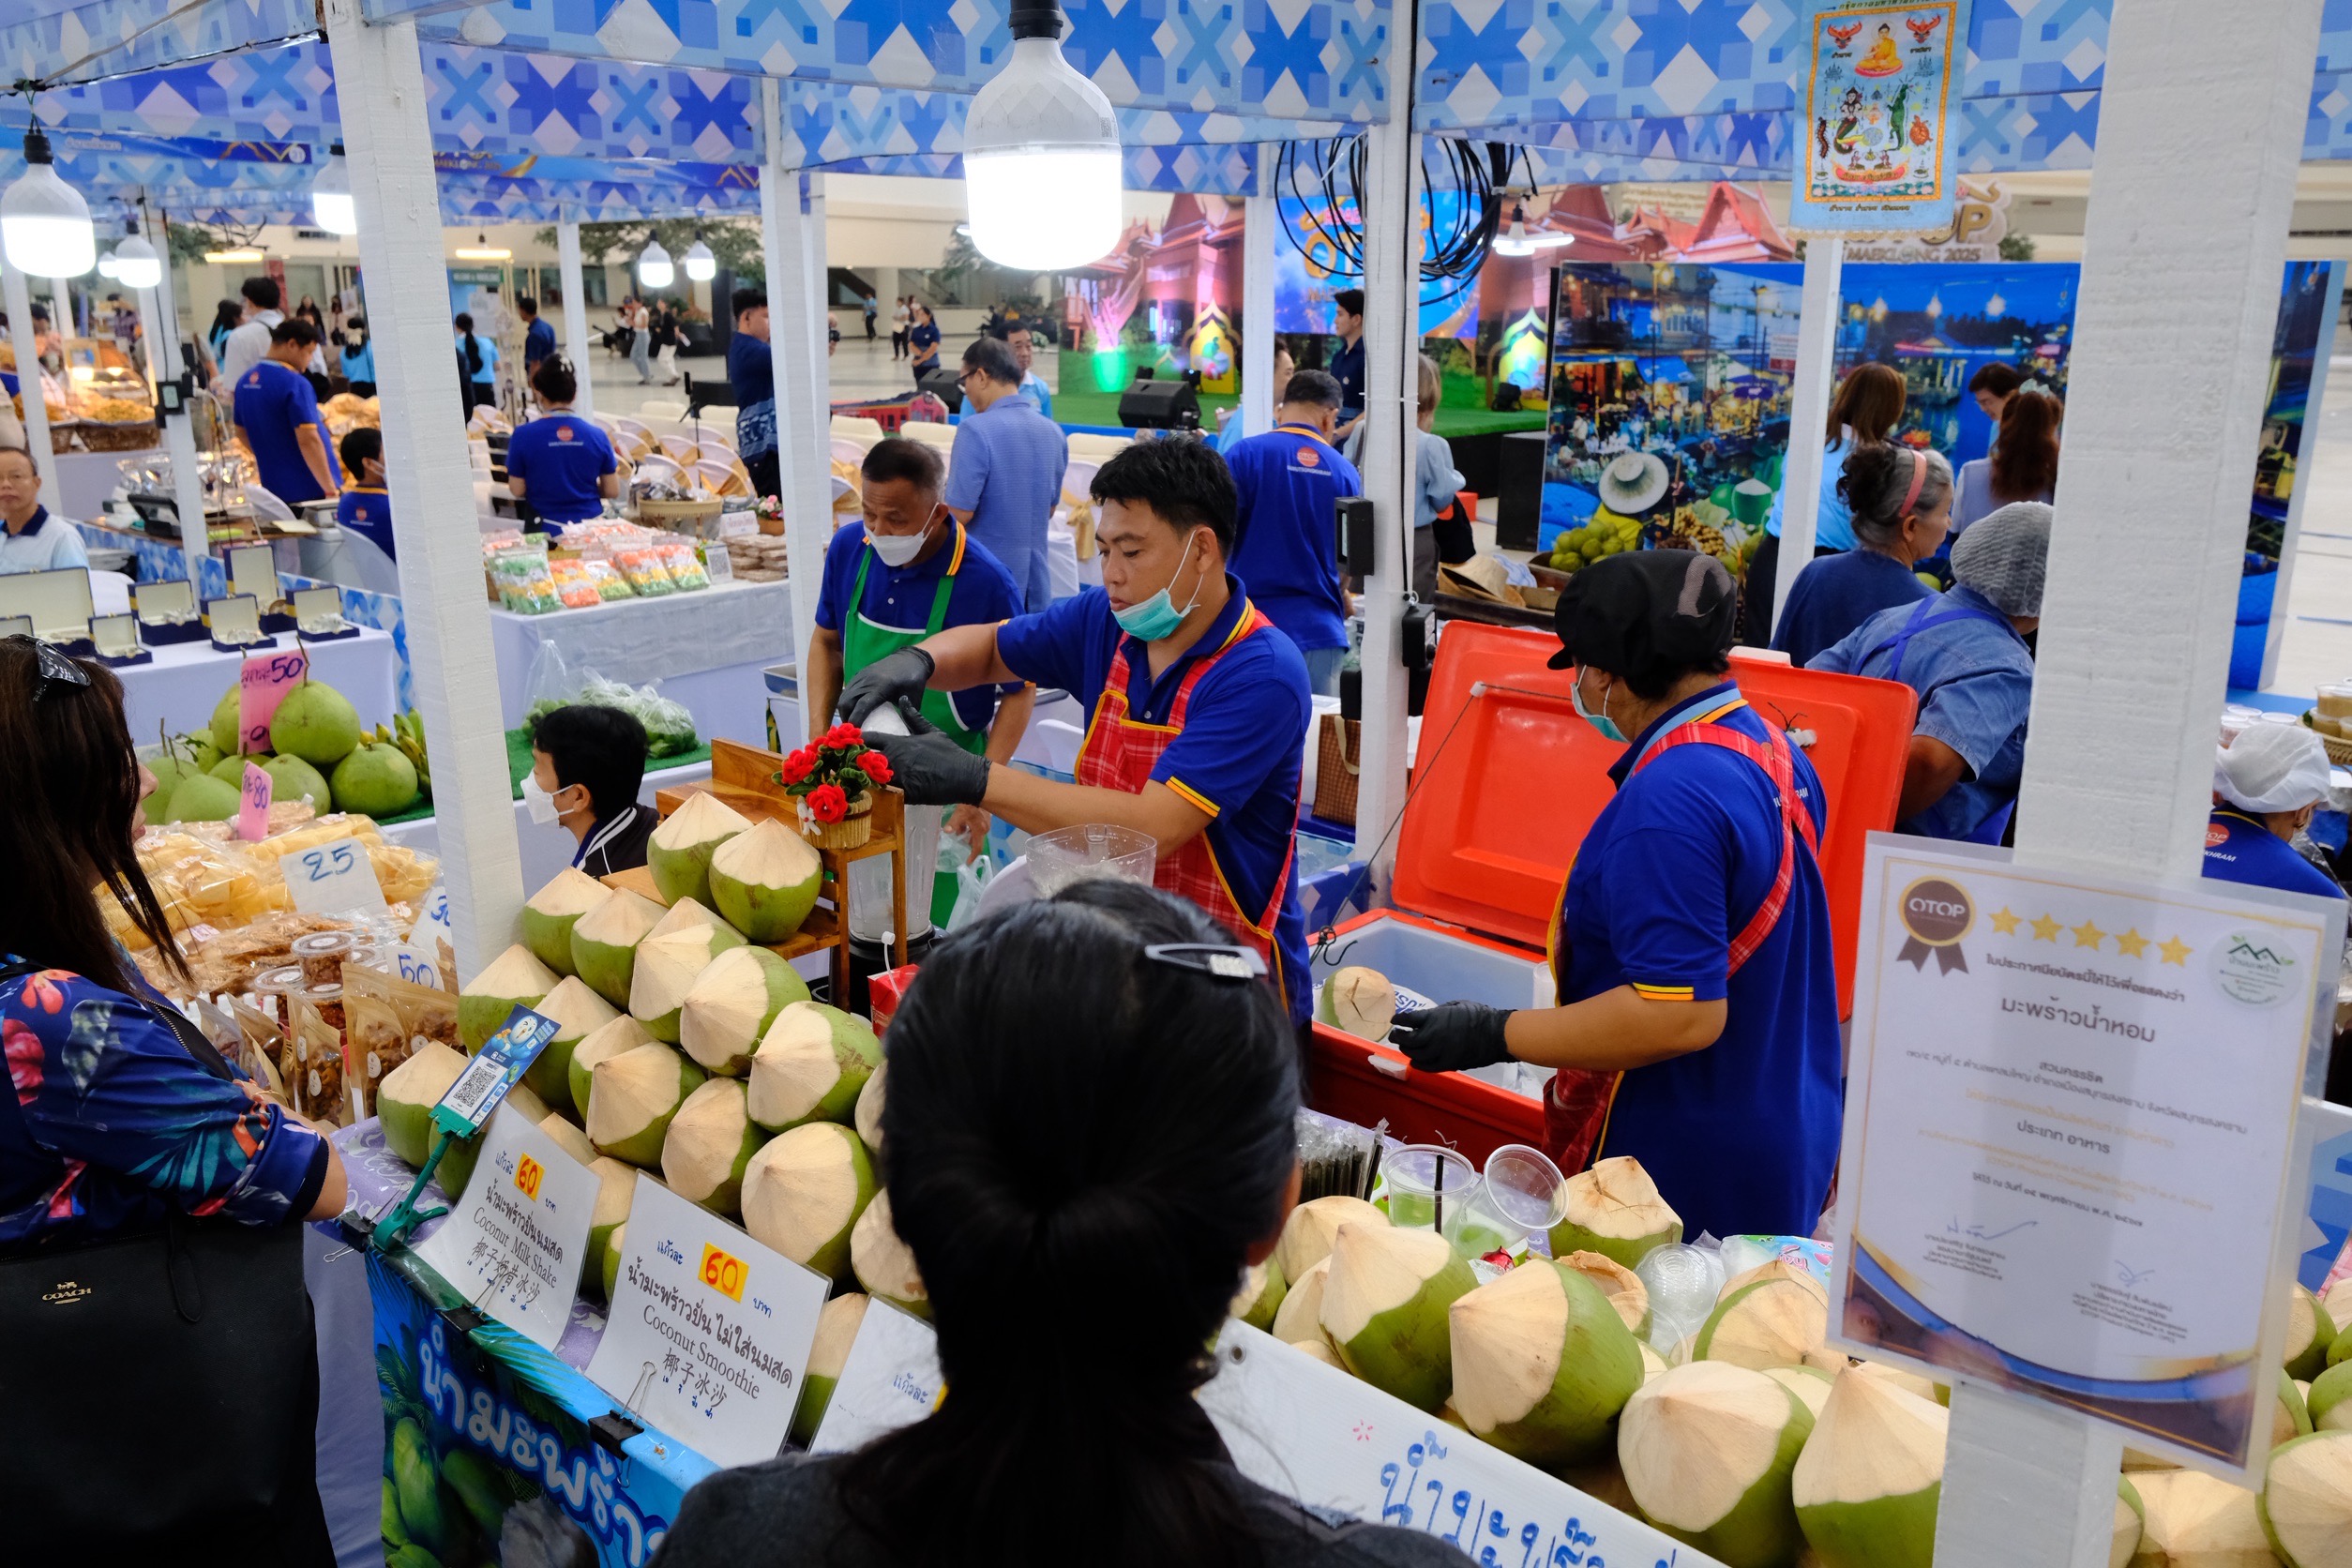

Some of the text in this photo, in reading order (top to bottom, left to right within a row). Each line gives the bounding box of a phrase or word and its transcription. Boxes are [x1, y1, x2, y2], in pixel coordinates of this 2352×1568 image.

[271, 656, 303, 683] 50
[253, 776, 268, 809] 80
[302, 843, 354, 882] 25
[1909, 897, 1966, 917] OTOP
[398, 954, 434, 988] 50
[2001, 997, 2156, 1044] มะพร้าวน้ำหอม
[2066, 1131, 2111, 1155] อาหาร
[519, 1158, 538, 1195] 60
[486, 1178, 563, 1264] น้ำมะพร้าวปั่นนมสด
[474, 1207, 509, 1247] Coconut
[511, 1236, 530, 1266] Milk
[531, 1254, 557, 1289] Shake
[42, 1287, 92, 1301] COACH
[705, 1251, 739, 1295] 60
[753, 1298, 772, 1318] บาท
[627, 1256, 793, 1389] น้ำมะพร้าวปั่น ไม่ใส่นมสด
[643, 1304, 696, 1355] Coconut
[697, 1341, 761, 1399] Smoothie
[663, 1348, 728, 1408] 椰子冰沙
